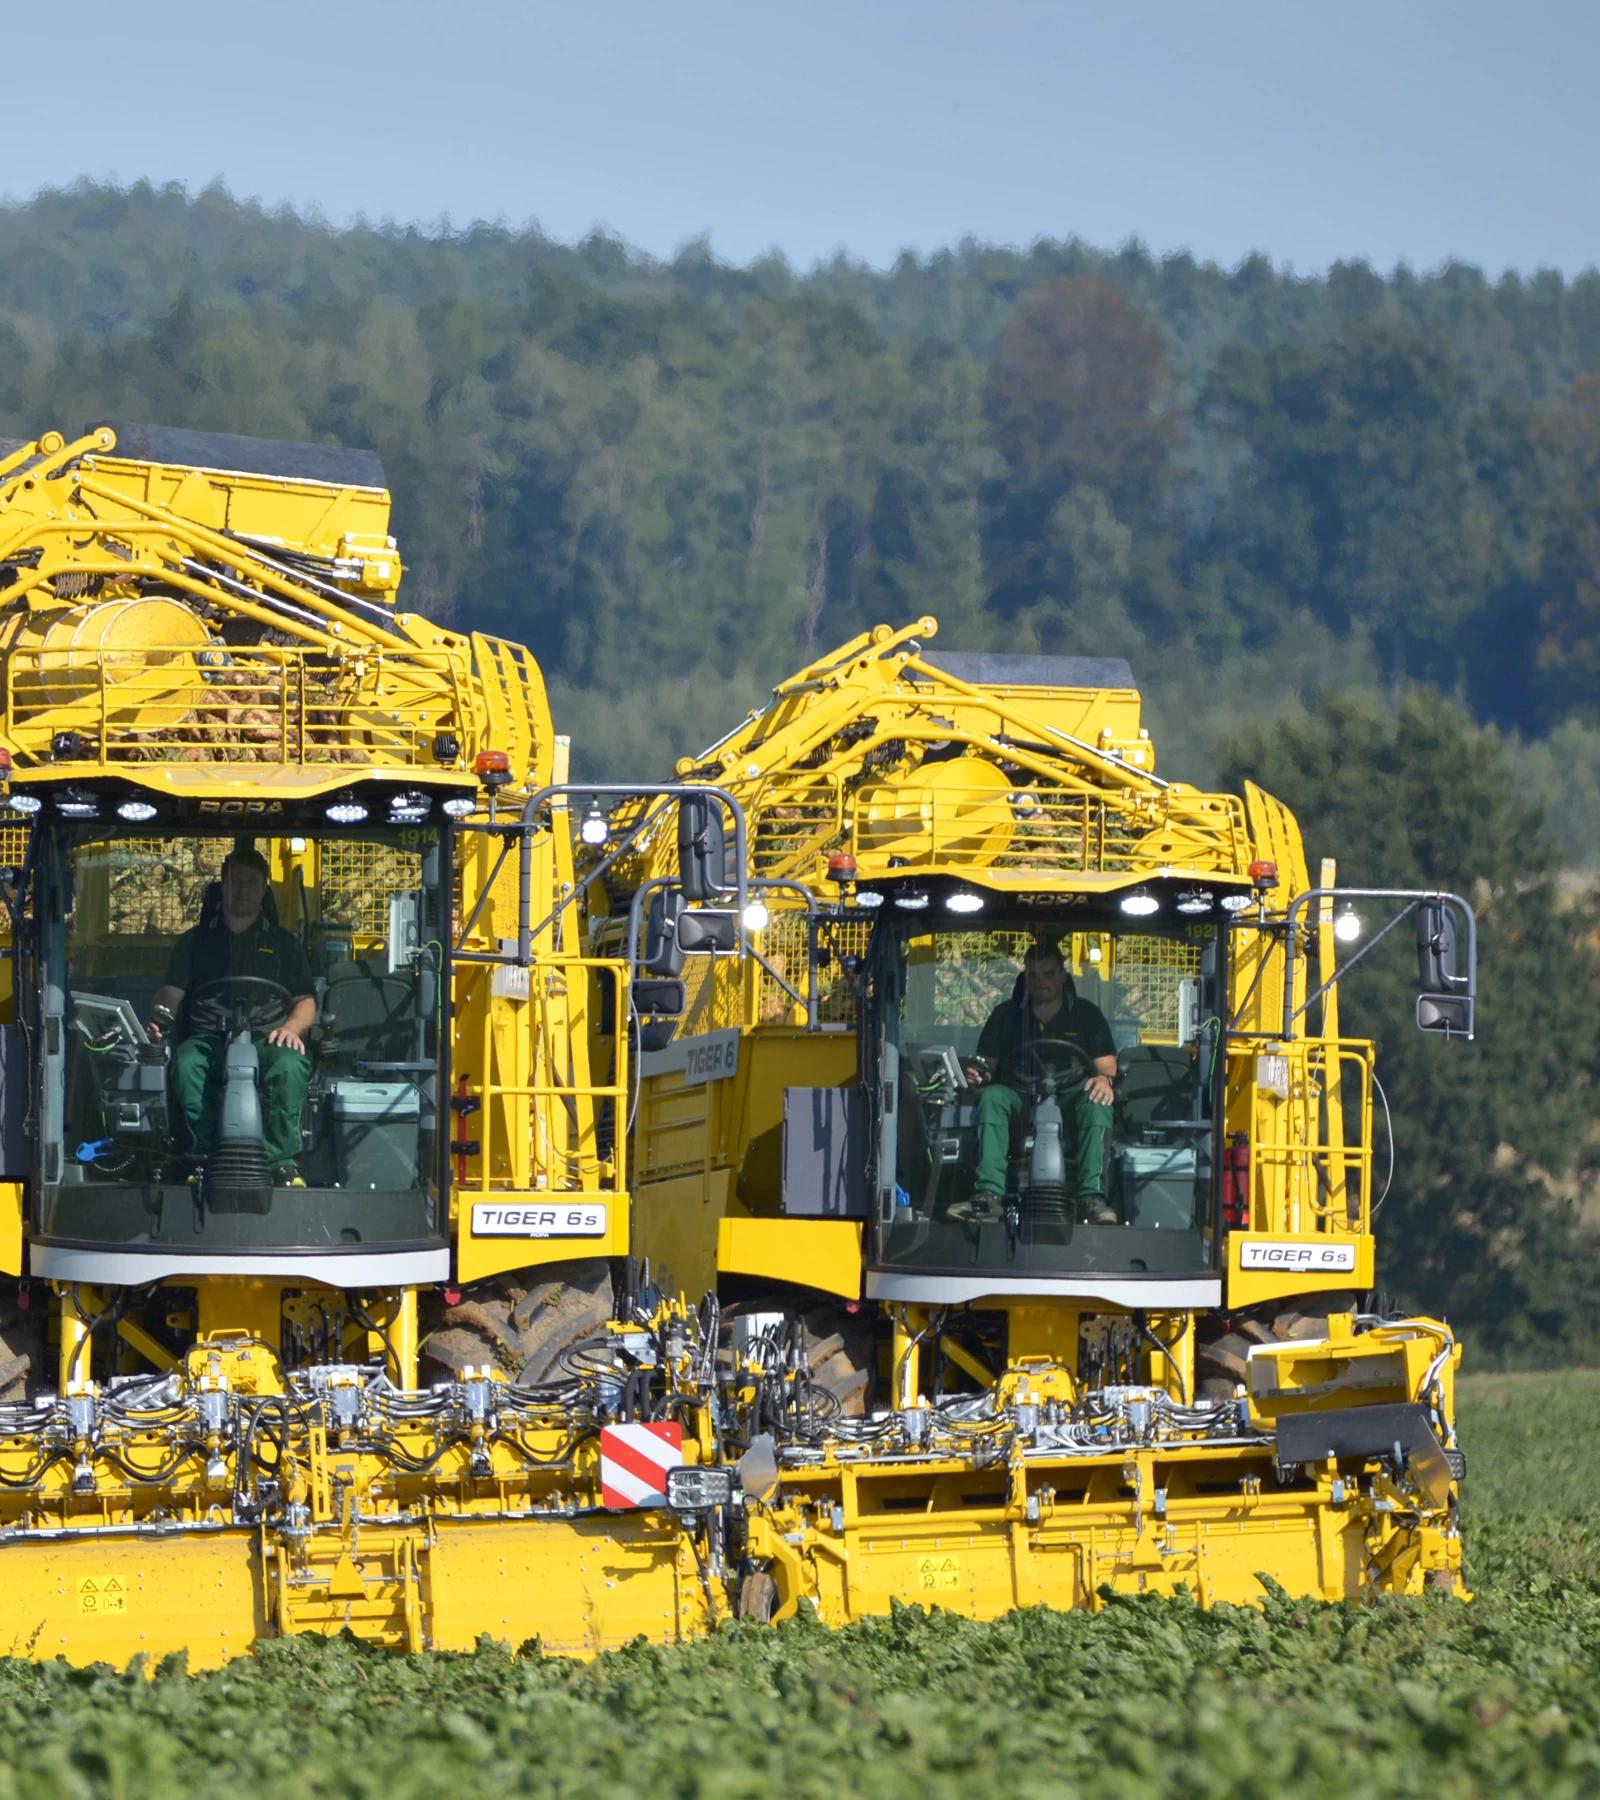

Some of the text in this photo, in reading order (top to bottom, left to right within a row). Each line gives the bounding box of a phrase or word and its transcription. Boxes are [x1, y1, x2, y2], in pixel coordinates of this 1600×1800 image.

[199, 801, 284, 816] ROPA
[399, 828, 439, 845] 1914
[687, 1041, 735, 1076] TIGER 6
[482, 1211, 598, 1226] TIGER 6s
[1250, 1249, 1348, 1263] TIGER 6s
